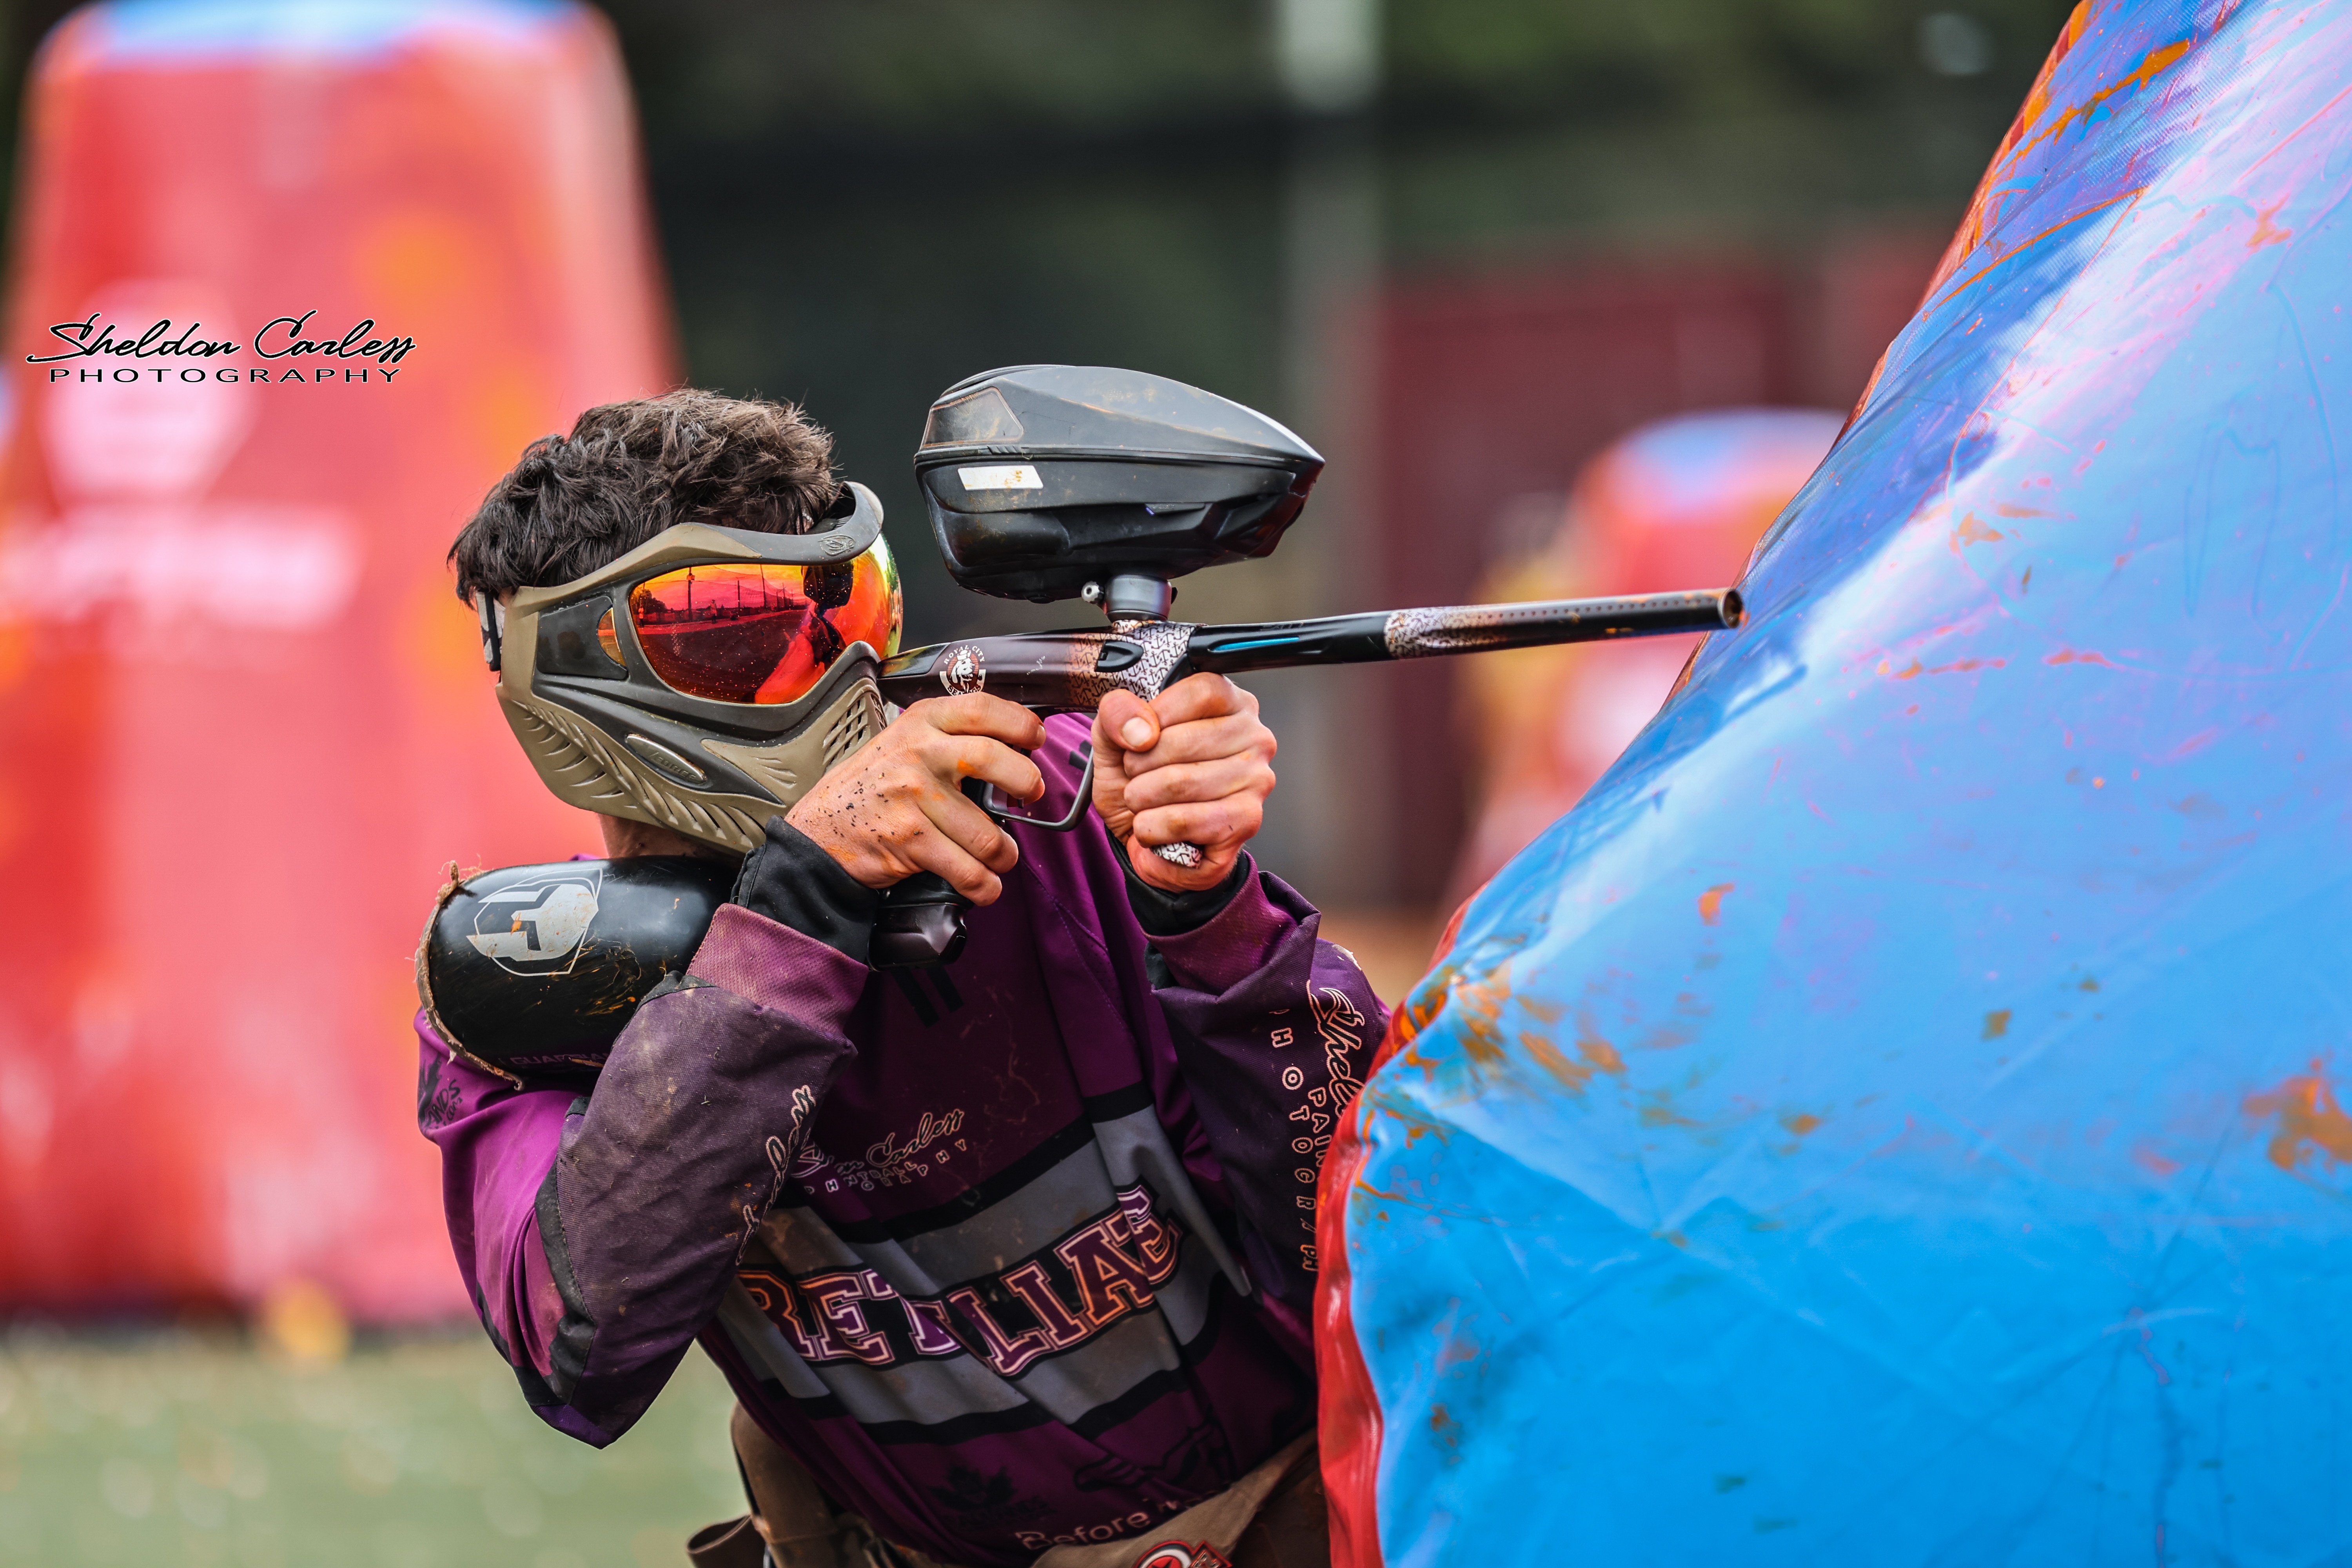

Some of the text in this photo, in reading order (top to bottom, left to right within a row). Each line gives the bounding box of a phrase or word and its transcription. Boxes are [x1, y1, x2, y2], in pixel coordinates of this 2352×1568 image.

[944, 645, 985, 664] ROYAL CITY
[866, 1108, 965, 1168] Carless
